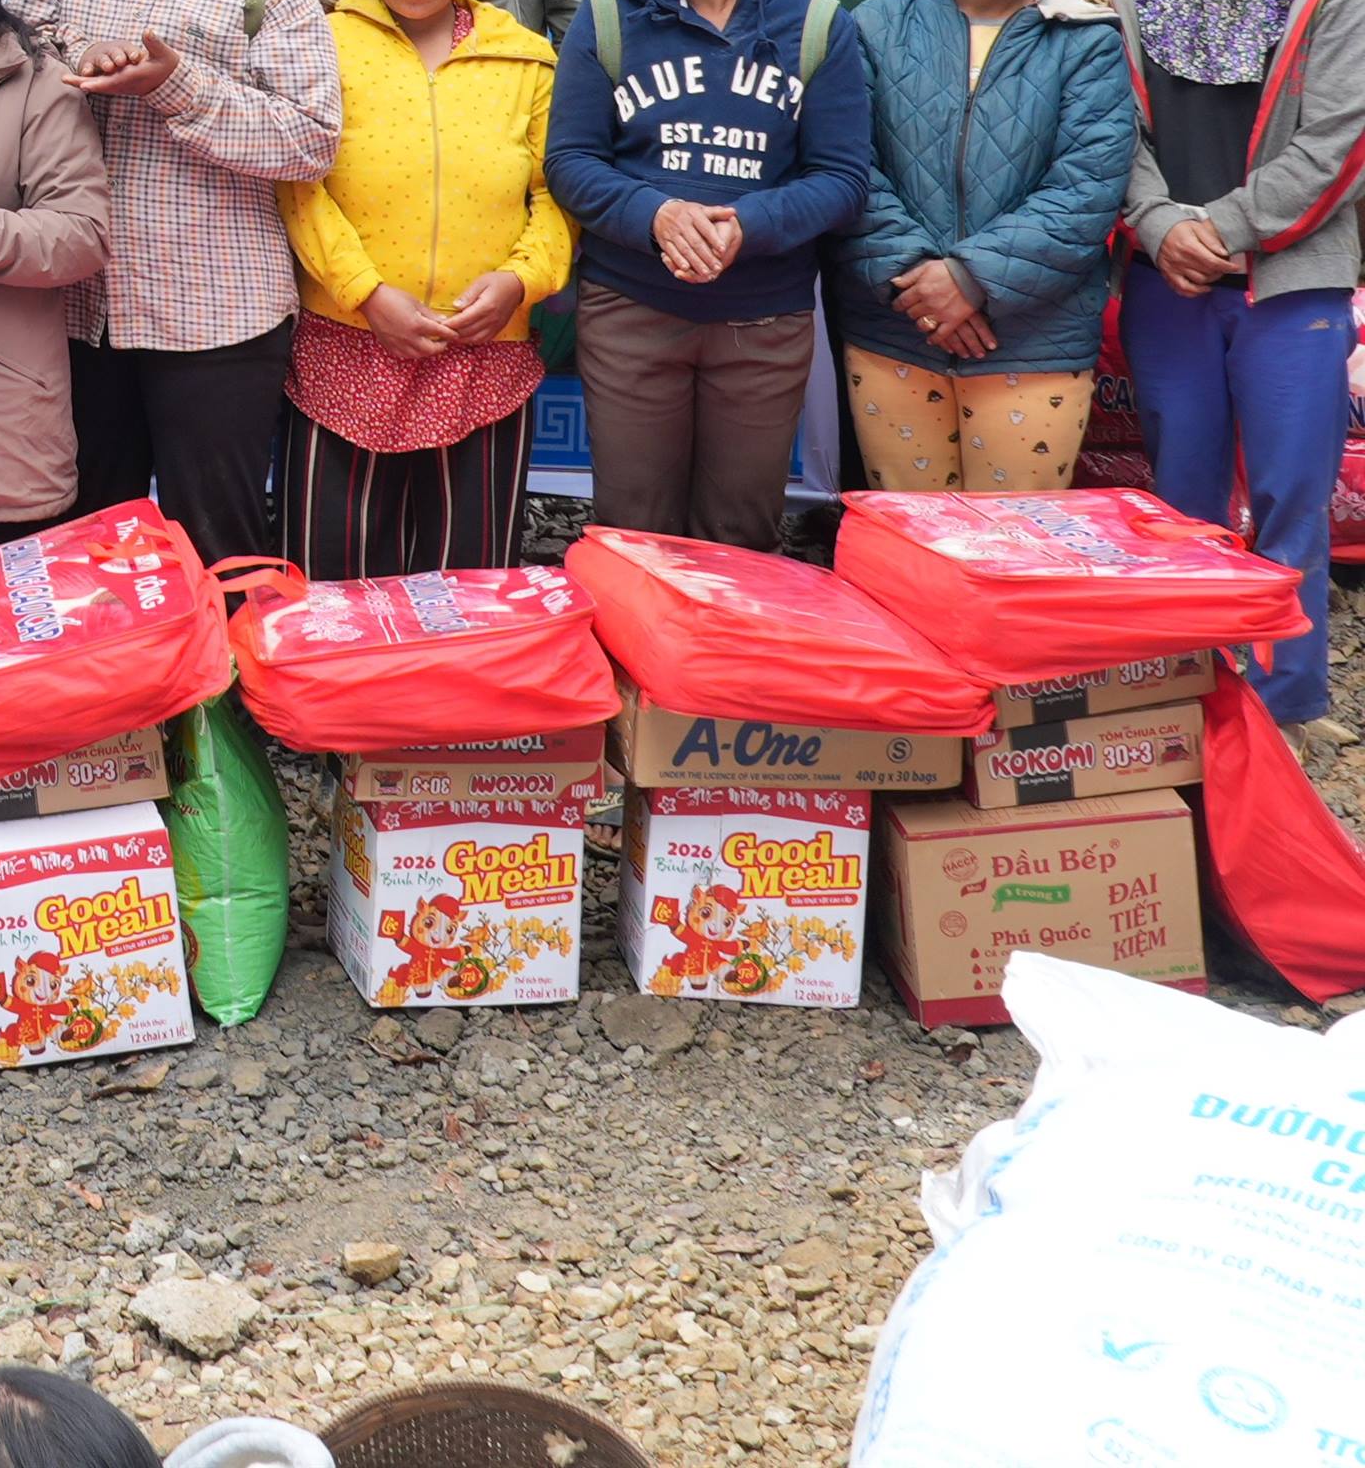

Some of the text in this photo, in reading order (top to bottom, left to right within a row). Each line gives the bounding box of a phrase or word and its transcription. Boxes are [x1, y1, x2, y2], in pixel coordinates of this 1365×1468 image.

[614, 56, 705, 122] BLUE
[660, 122, 767, 152] EST.2011
[662, 149, 763, 180] 1ST TRACK
[1120, 657, 1167, 685] 30+3
[672, 717, 822, 767] A-One
[1103, 741, 1153, 770] 30+3
[68, 758, 117, 787] 30+3
[687, 771, 702, 780] THE
[989, 741, 1096, 779] KOKOMI
[411, 777, 450, 794] 30+3
[469, 772, 556, 796] KOKOMI
[856, 771, 875, 781] 400
[878, 774, 884, 784] g
[896, 771, 909, 781] 30
[912, 770, 937, 784] bags
[393, 856, 436, 869] 2026
[444, 833, 549, 877] Good
[667, 843, 712, 858] 2026
[722, 831, 832, 867] Good
[992, 844, 1117, 878] Đầu Bếp
[460, 854, 577, 906] Meall
[739, 855, 861, 899] Meall
[1108, 873, 1158, 906] ĐẠI
[34, 876, 142, 931] Good
[1016, 888, 1053, 901] trong
[58, 893, 175, 960] Meall
[1109, 901, 1162, 933] TIẾT
[992, 922, 1091, 947] Phú Quốc
[1113, 926, 1167, 962] KIỆM
[514, 987, 543, 998] 12 chai
